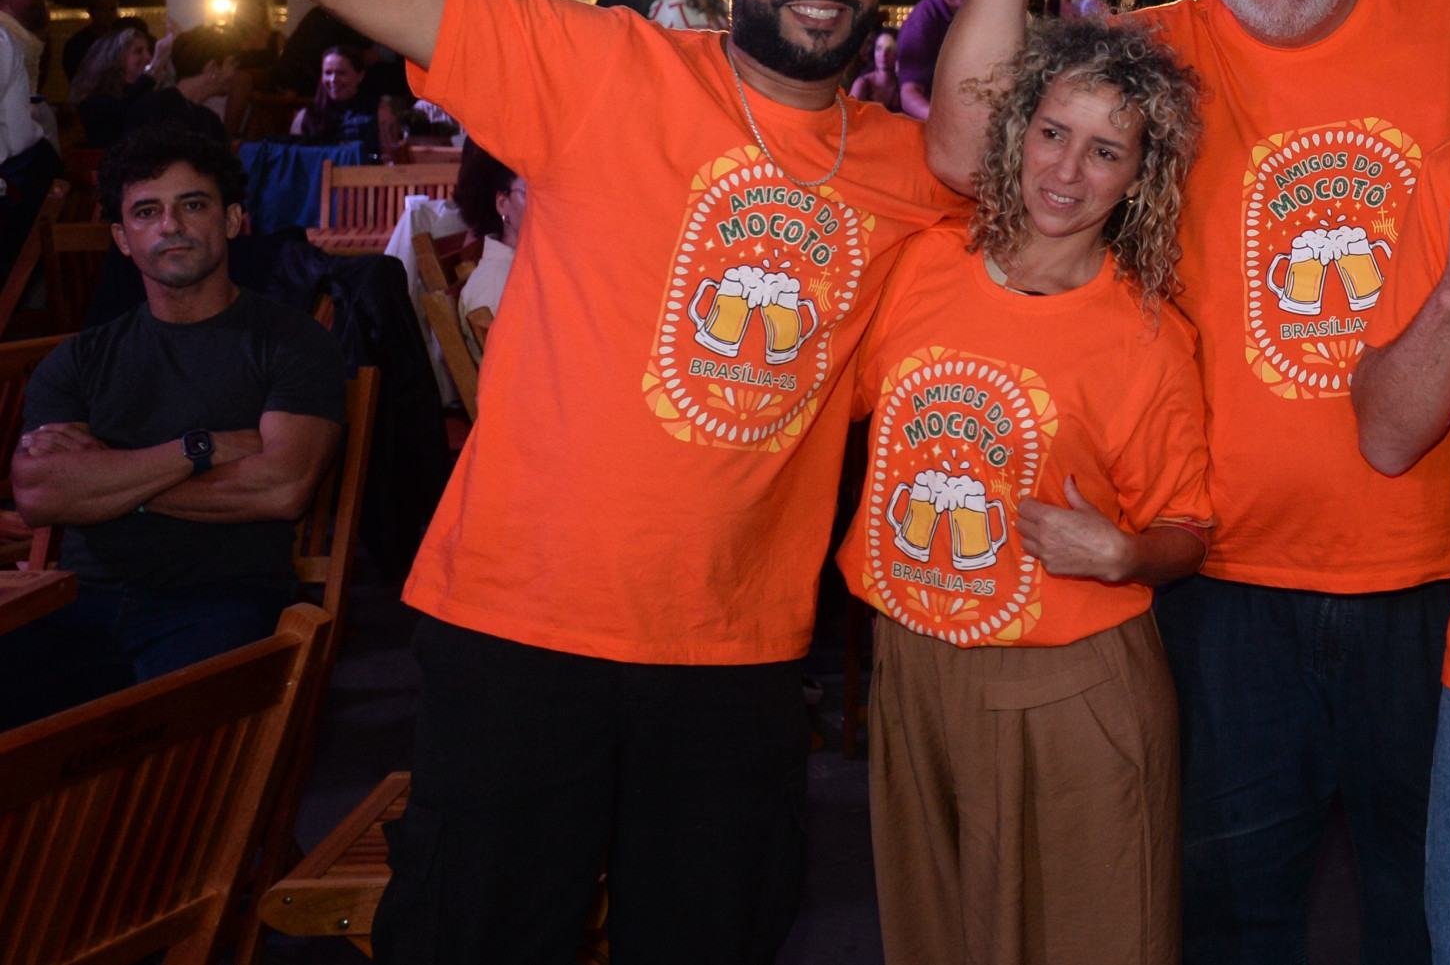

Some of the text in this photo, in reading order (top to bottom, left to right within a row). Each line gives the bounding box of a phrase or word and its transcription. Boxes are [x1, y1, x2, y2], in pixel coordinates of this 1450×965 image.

[1274, 151, 1384, 190] AMIGOS DO
[729, 186, 839, 236] AMIGOS DO
[1269, 176, 1391, 222] MOCOTÓ
[717, 212, 837, 267] MOCOTÓ
[689, 358, 798, 390] BRASÍLIA-25
[911, 383, 1014, 436] AMIGOS DO
[903, 411, 1014, 468] MOCOTÓ
[892, 561, 996, 596] BRASÍLIA-25
